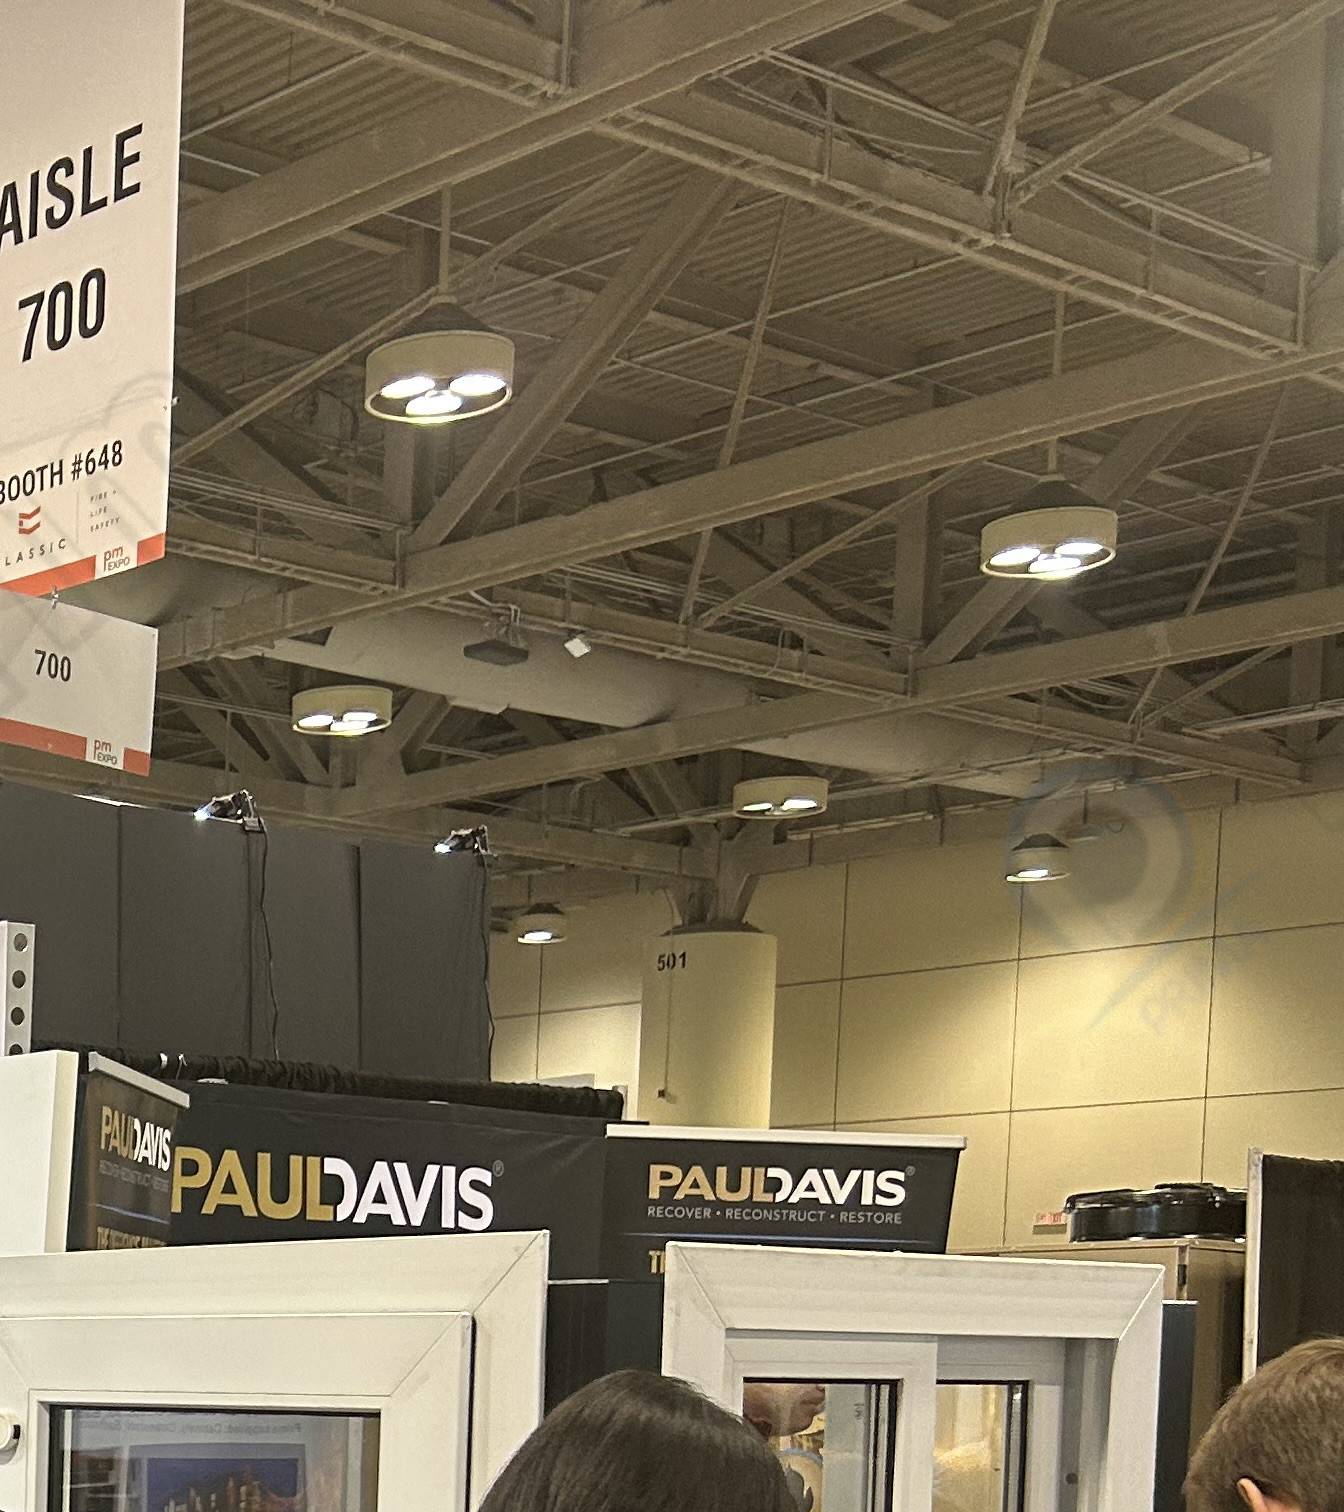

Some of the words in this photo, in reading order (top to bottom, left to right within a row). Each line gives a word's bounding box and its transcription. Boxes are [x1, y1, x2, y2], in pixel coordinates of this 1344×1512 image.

[18, 267, 107, 363] 700
[70, 440, 123, 481] #648
[103, 546, 124, 572] pm
[107, 556, 130, 571] EXPO
[34, 648, 71, 682] 700
[657, 951, 687, 972] 501
[648, 1206, 711, 1219] RECOVER
[725, 1208, 825, 1222] RECONSTRUCT
[840, 1211, 902, 1224] RESTORE
